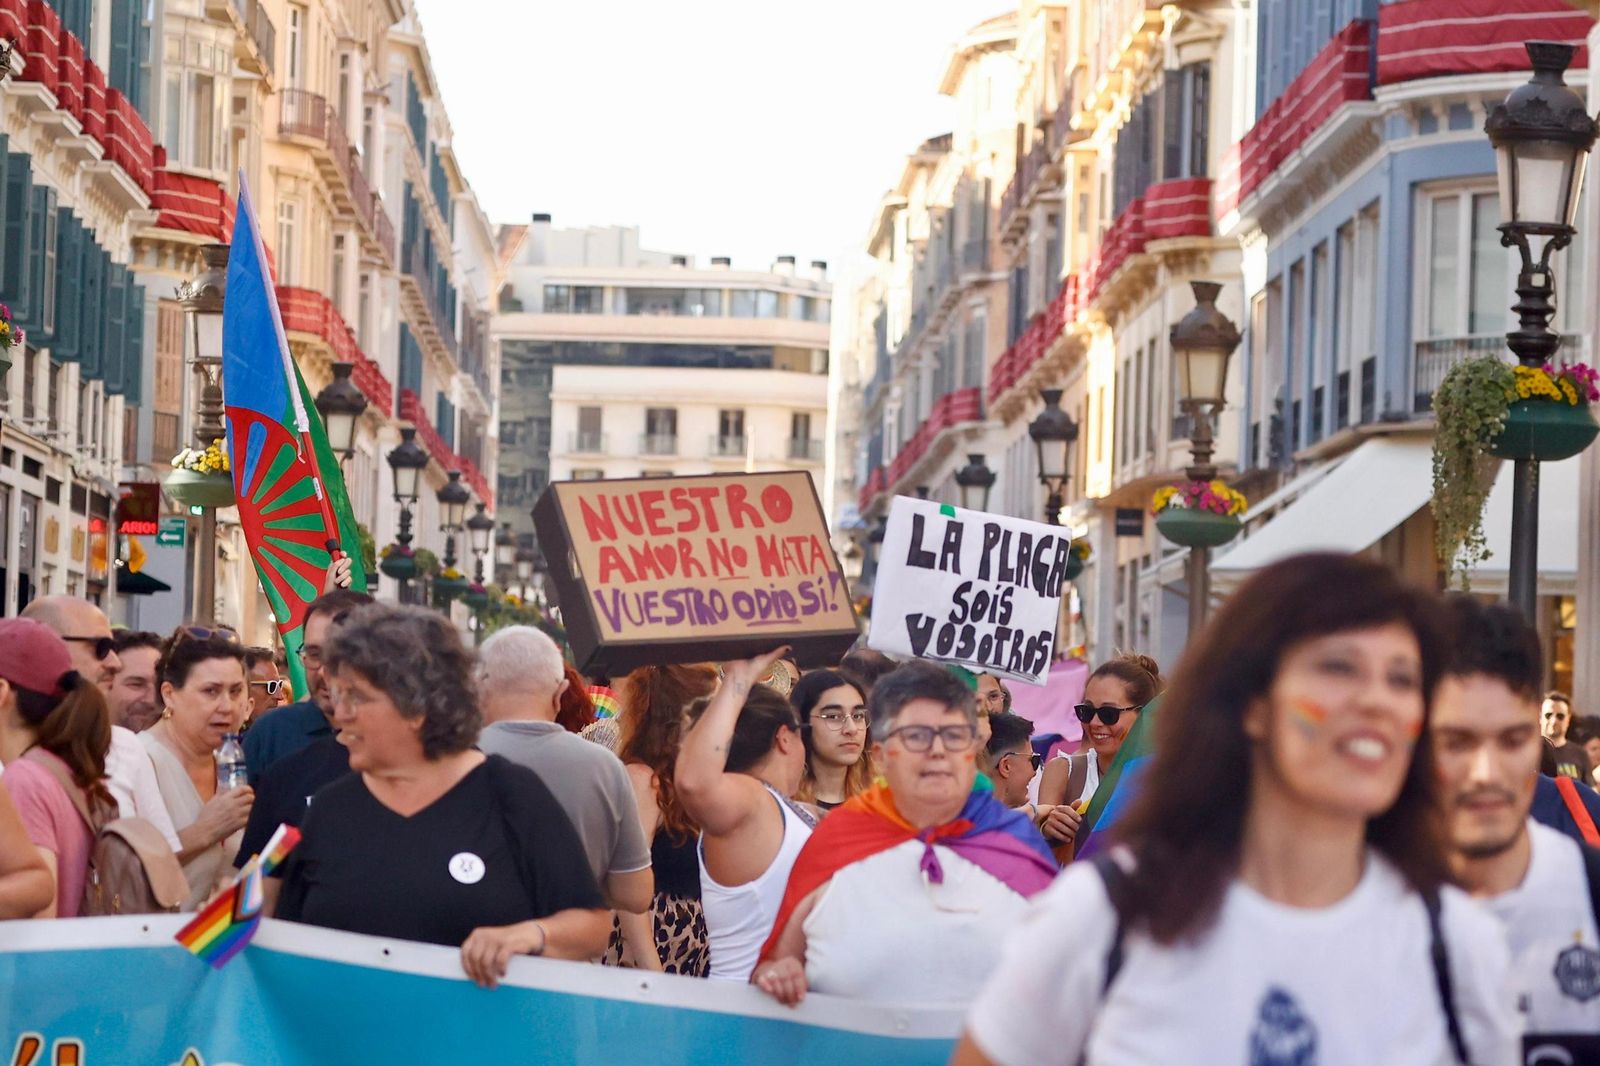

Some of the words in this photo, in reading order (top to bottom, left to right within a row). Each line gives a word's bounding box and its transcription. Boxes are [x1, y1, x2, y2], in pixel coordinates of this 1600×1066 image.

[579, 484, 793, 542] NUESTRO
[706, 537, 748, 577] NO
[755, 534, 830, 577] MATA
[906, 513, 964, 575] LA
[978, 522, 1070, 598] PLAGA
[593, 587, 729, 633] VUESTRO
[905, 612, 1052, 676] VOSOTROS
